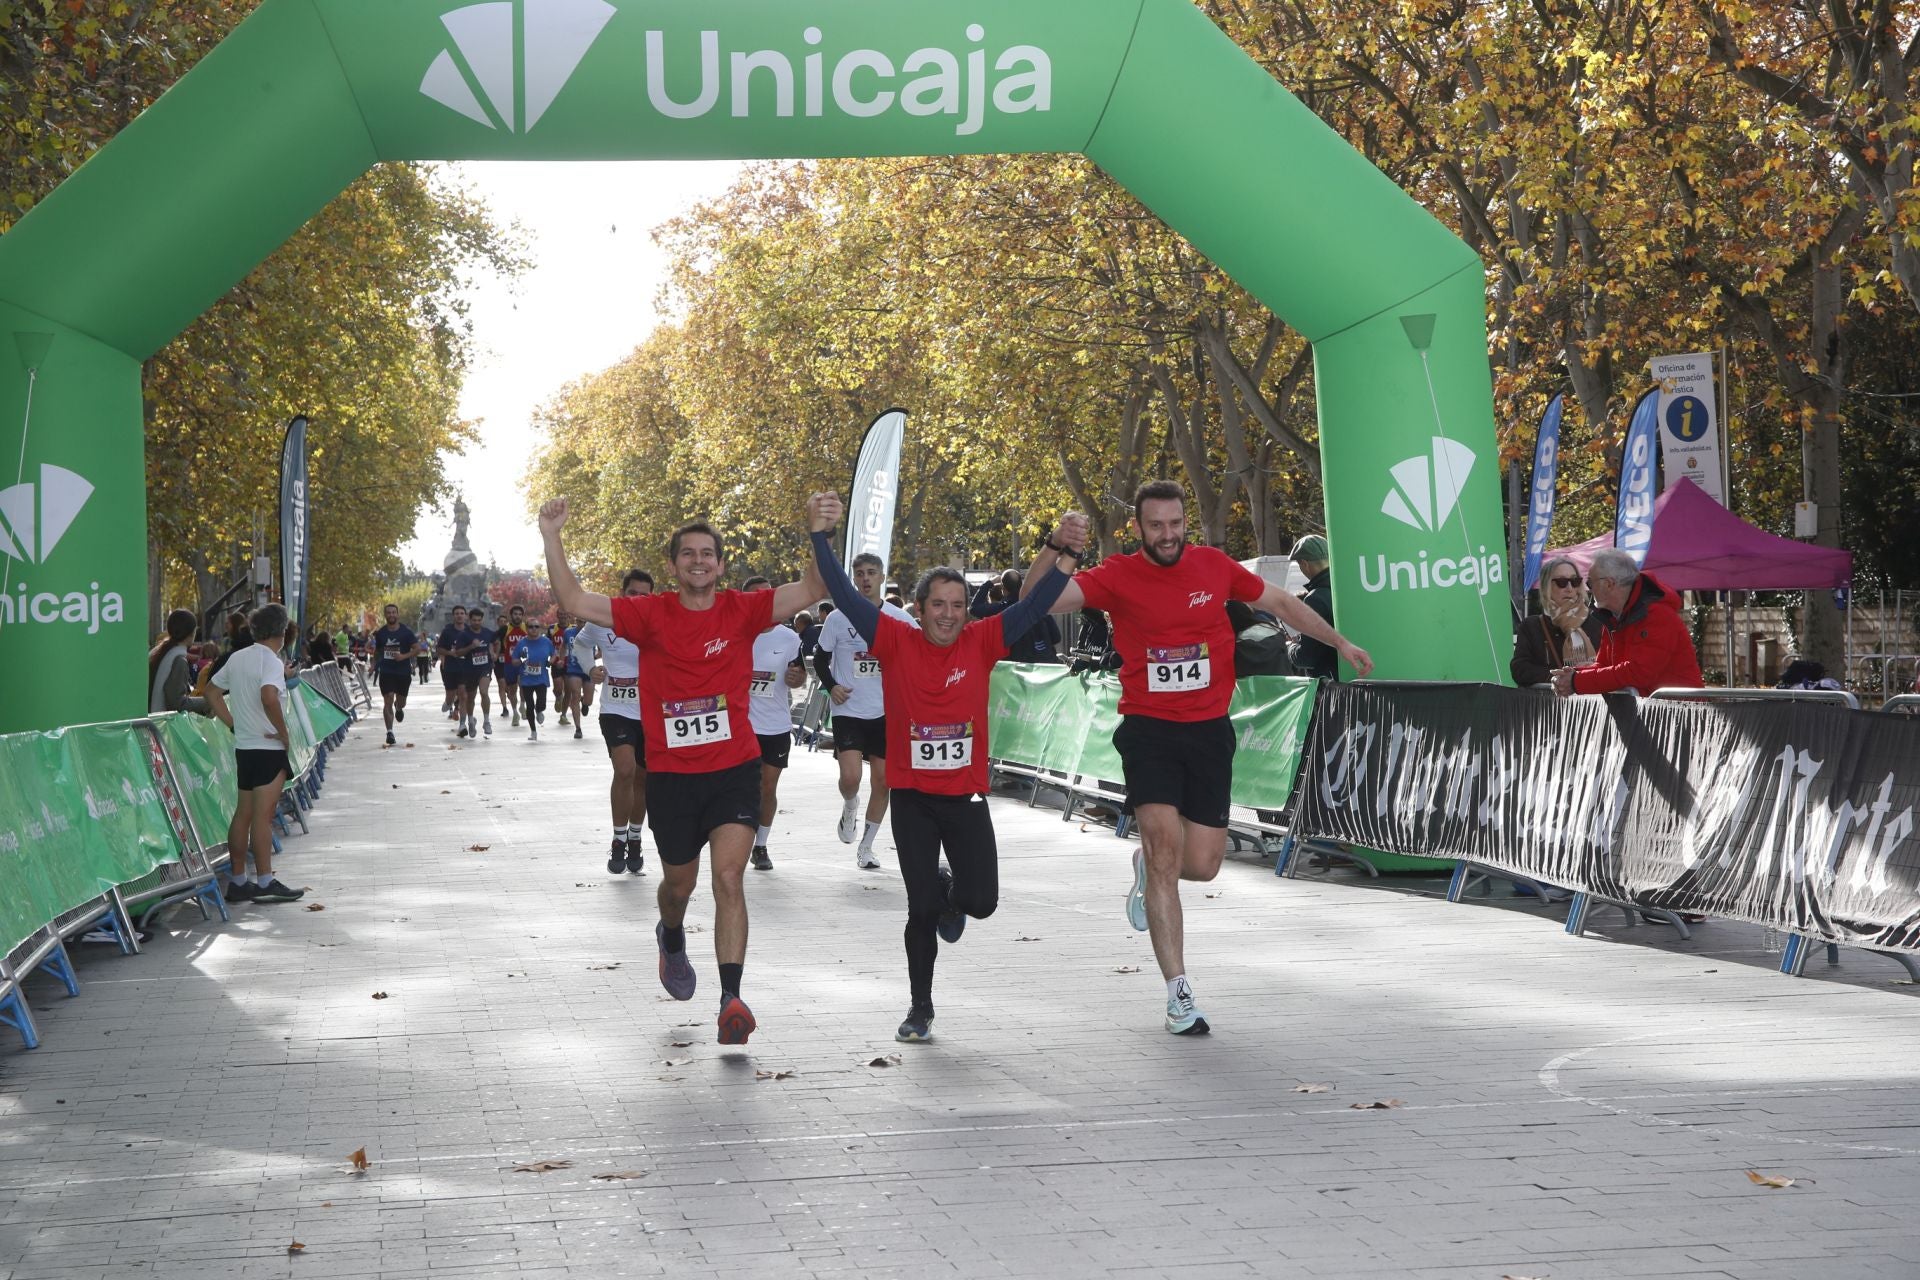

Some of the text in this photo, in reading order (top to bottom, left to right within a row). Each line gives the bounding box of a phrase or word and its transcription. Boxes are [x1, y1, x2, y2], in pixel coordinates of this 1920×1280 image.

[645, 24, 1052, 136] Unicaja
[1659, 362, 1696, 373] Oficina de
[1359, 545, 1503, 596] Unicaja
[1188, 591, 1214, 609] Talgo
[704, 637, 730, 658] Talgo
[1156, 662, 1202, 683] 914
[611, 687, 637, 699] 878
[673, 714, 720, 738] 915
[920, 741, 964, 761] 913
